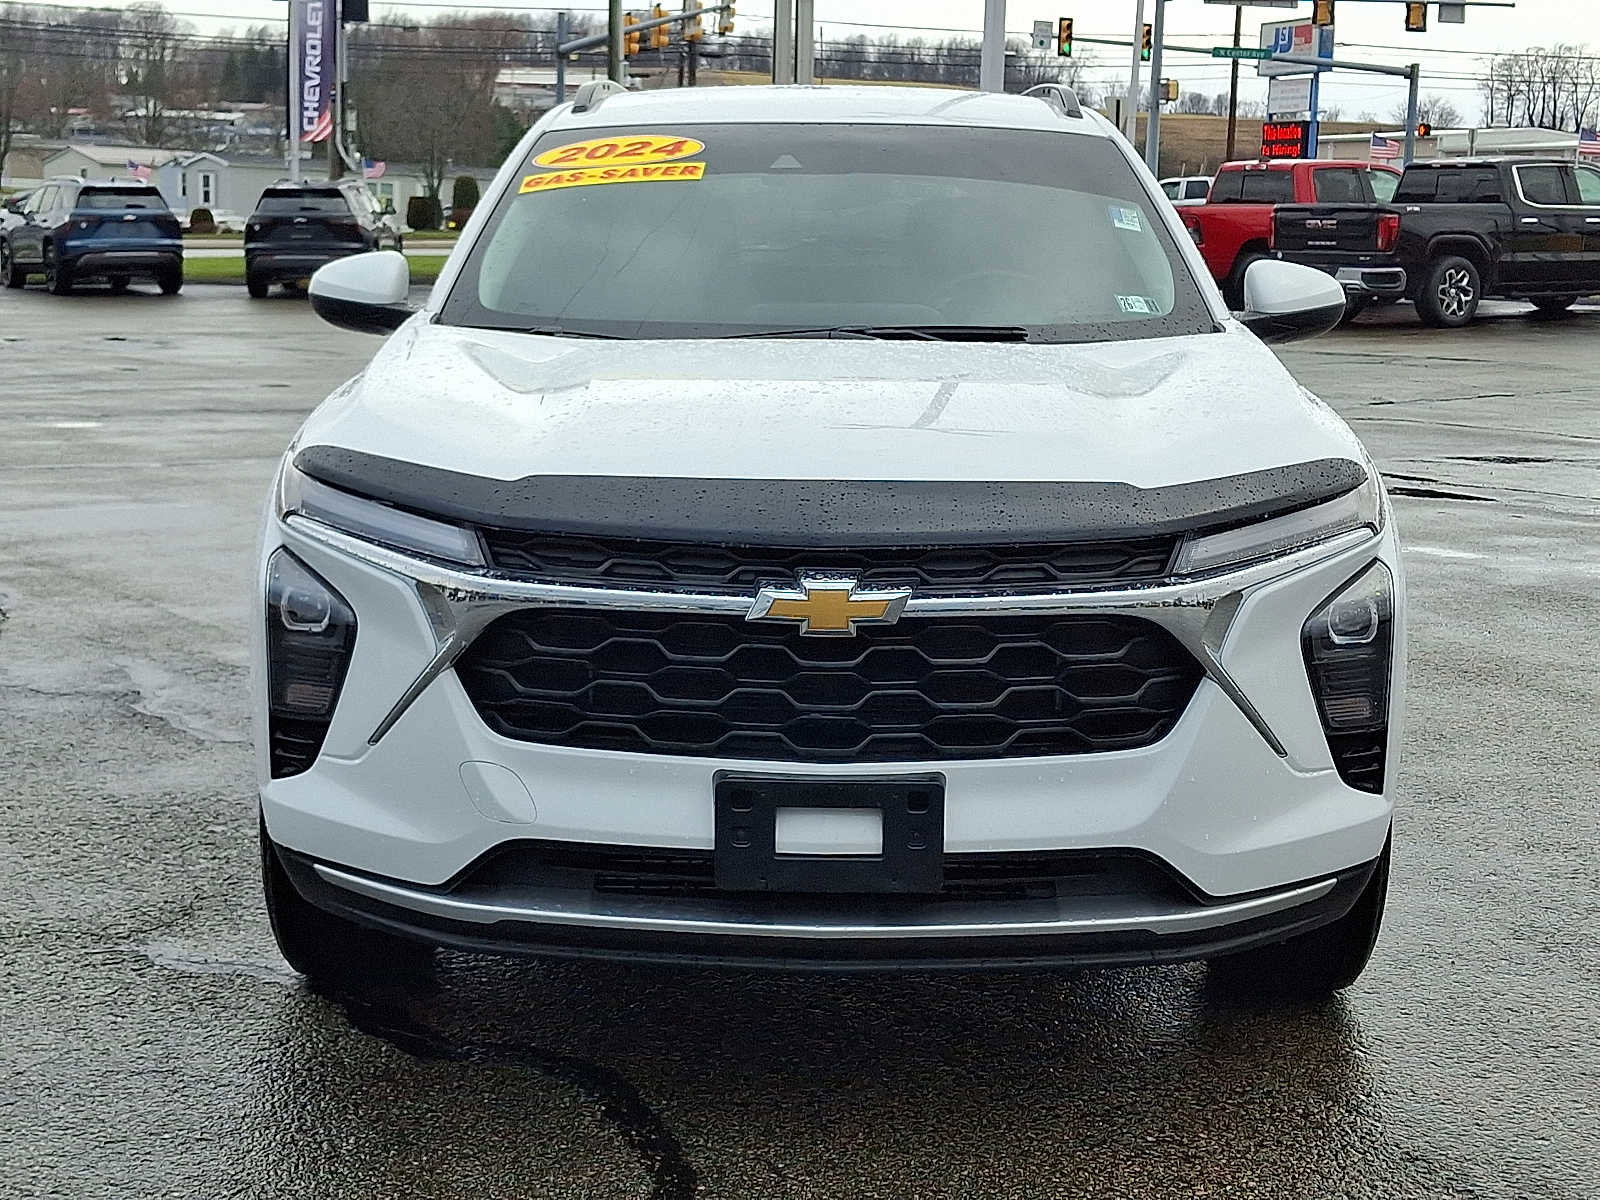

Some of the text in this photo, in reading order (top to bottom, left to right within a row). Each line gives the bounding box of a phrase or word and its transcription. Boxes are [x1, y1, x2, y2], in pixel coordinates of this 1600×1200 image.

[1263, 123, 1301, 141] This location
[549, 140, 689, 165] 2024
[1272, 143, 1301, 157] Hiring!
[523, 164, 702, 189] GAS-SAVER
